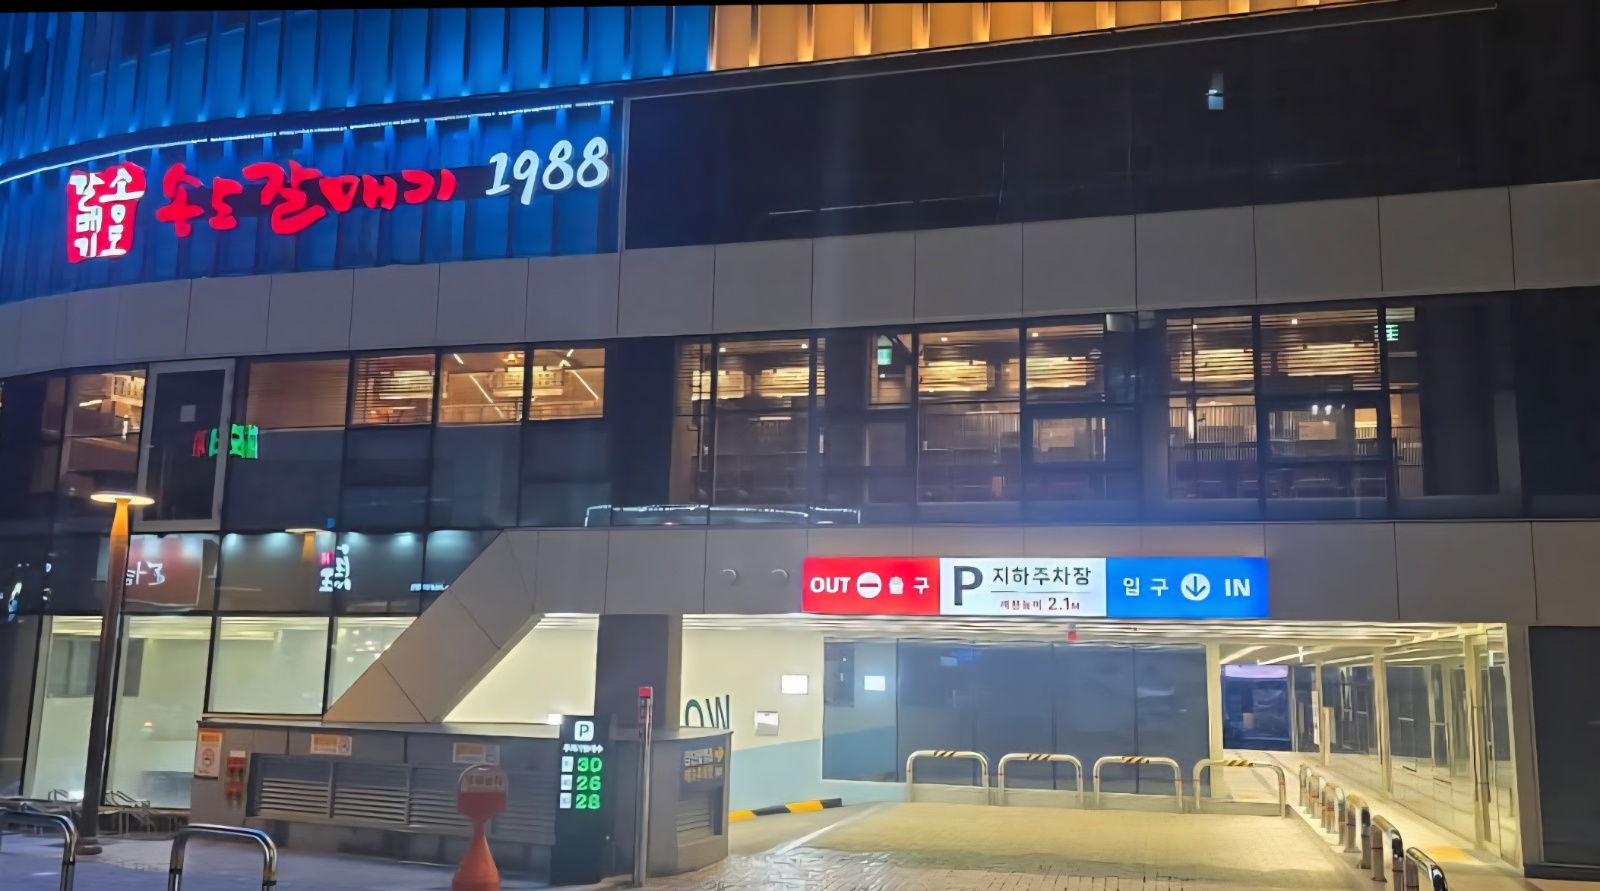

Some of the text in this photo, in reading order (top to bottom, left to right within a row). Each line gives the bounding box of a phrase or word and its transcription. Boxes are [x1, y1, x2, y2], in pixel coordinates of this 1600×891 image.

[485, 136, 610, 206] 1988
[810, 576, 850, 595] OUT
[953, 565, 984, 607] P
[992, 566, 1092, 588] 지하주차장
[1122, 577, 1251, 597] 입구 IN
[577, 757, 603, 773] 30
[576, 775, 602, 791] 26
[575, 793, 601, 810] 28
